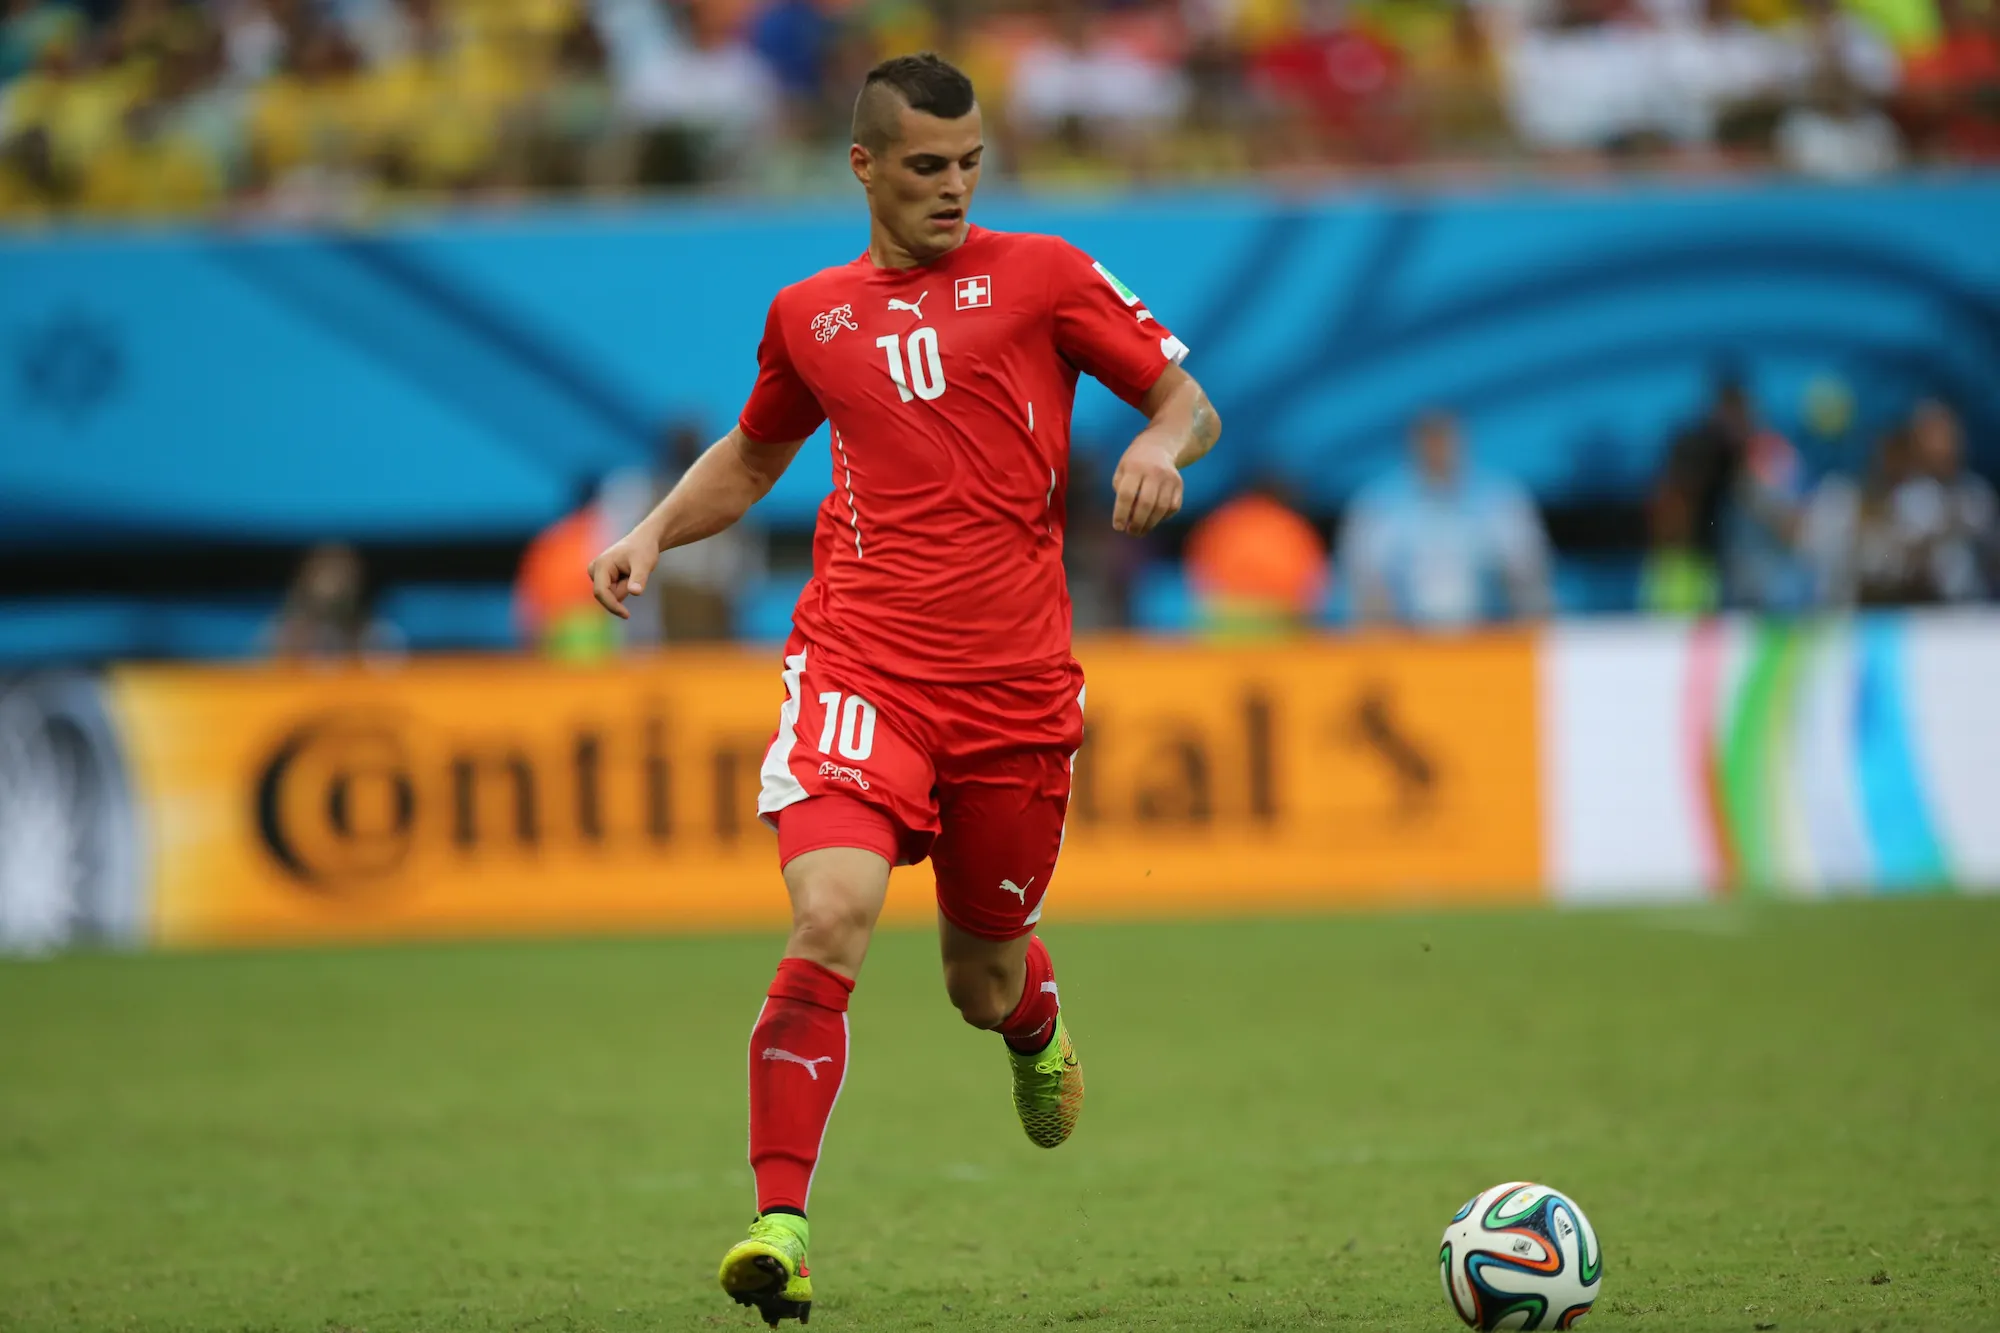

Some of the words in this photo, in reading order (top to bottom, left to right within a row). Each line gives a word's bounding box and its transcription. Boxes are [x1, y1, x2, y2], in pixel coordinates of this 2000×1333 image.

[876, 326, 947, 403] 10
[818, 691, 877, 761] 10
[250, 685, 1280, 892] Contital
